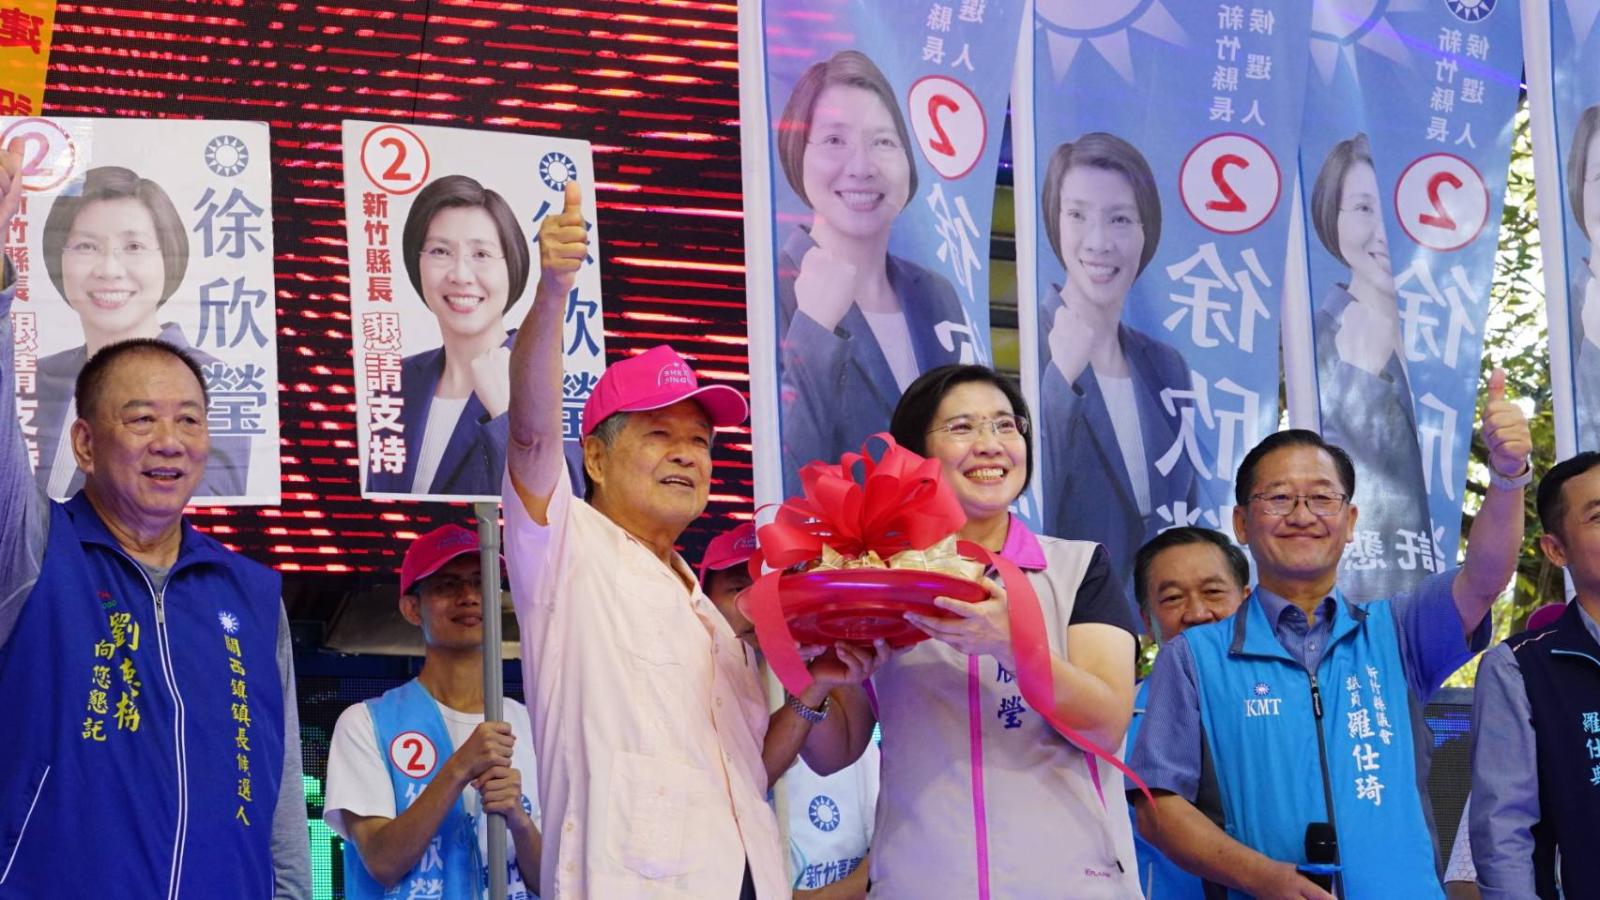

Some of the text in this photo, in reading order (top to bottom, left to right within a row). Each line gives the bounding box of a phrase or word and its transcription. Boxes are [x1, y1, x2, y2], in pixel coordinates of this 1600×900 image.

[7, 131, 53, 177] 2
[379, 137, 411, 180] 2
[362, 191, 392, 302] 新竹縣長
[192, 187, 269, 437] 徐欣瑩
[10, 312, 40, 476] 懇請支
[362, 312, 407, 474] 懇請支持
[81, 640, 116, 742] 向您懇託
[224, 634, 252, 826] 關西鎮鎮長候選人
[1244, 697, 1282, 718] KMT
[402, 738, 426, 771] 2
[1347, 708, 1385, 807] 羅仕琦
